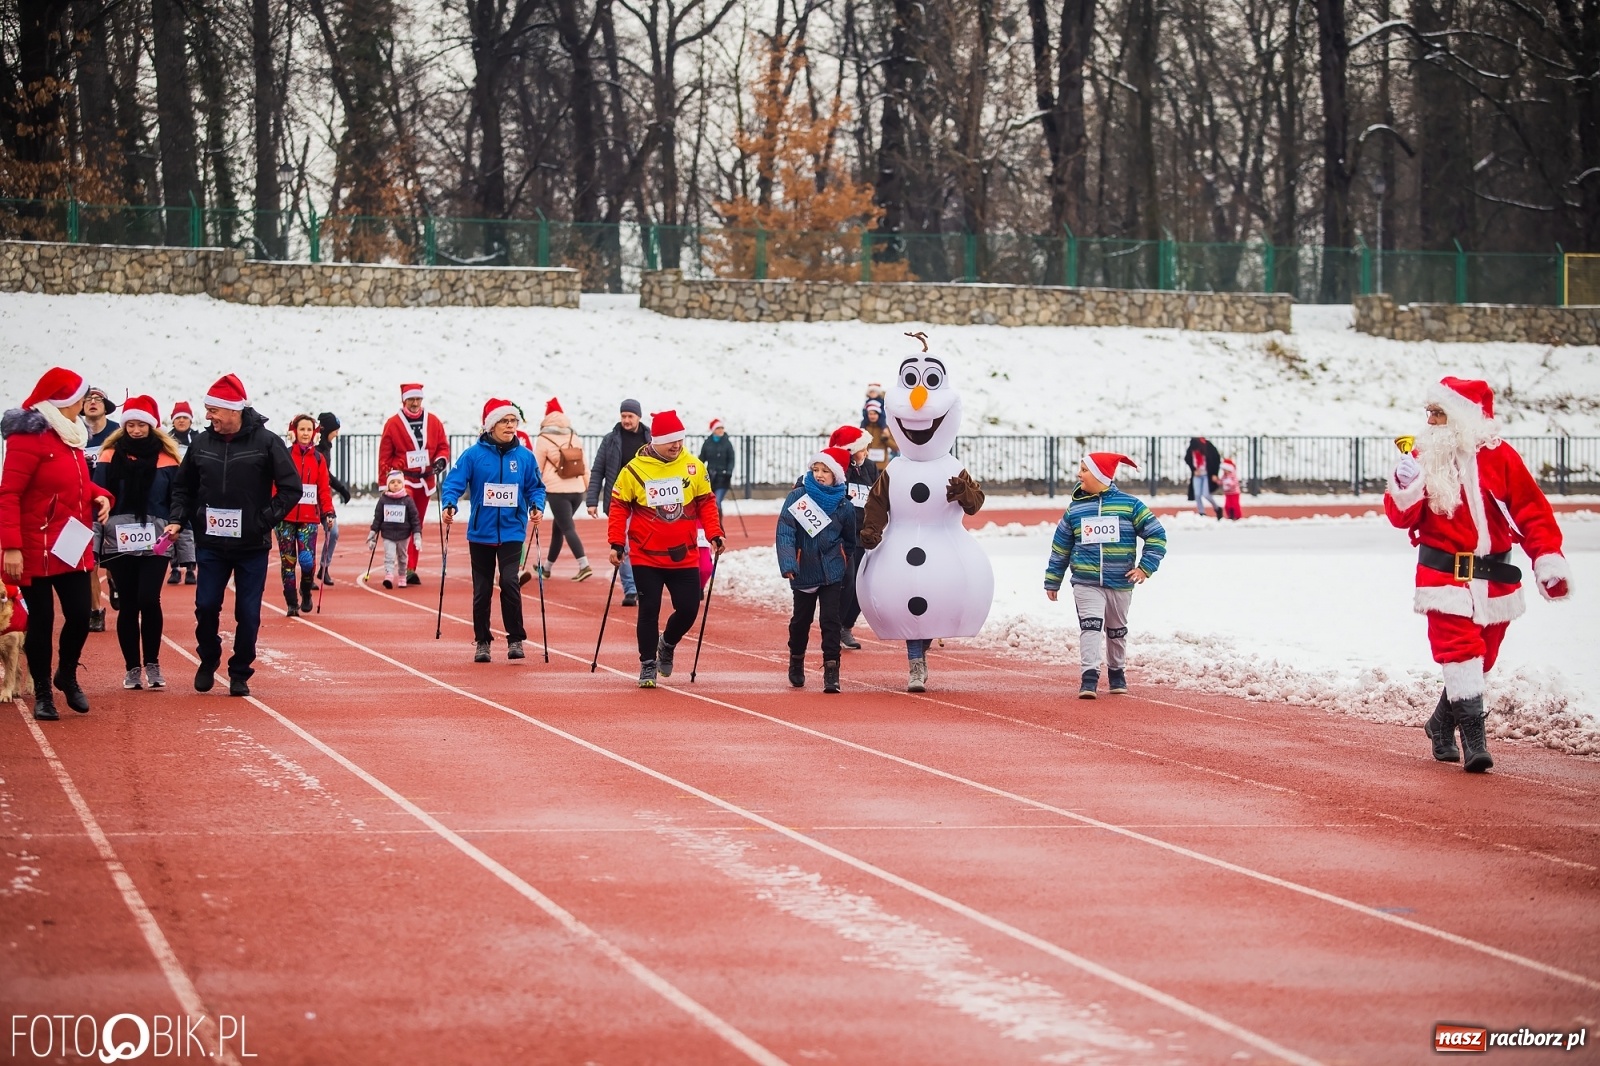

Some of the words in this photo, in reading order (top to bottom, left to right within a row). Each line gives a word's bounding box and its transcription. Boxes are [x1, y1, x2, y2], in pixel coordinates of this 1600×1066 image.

[495, 491, 513, 500] 061
[658, 486, 679, 497] 010
[217, 518, 239, 528] 025
[803, 509, 822, 530] 022
[1094, 525, 1116, 535] 003
[129, 532, 152, 543] 020
